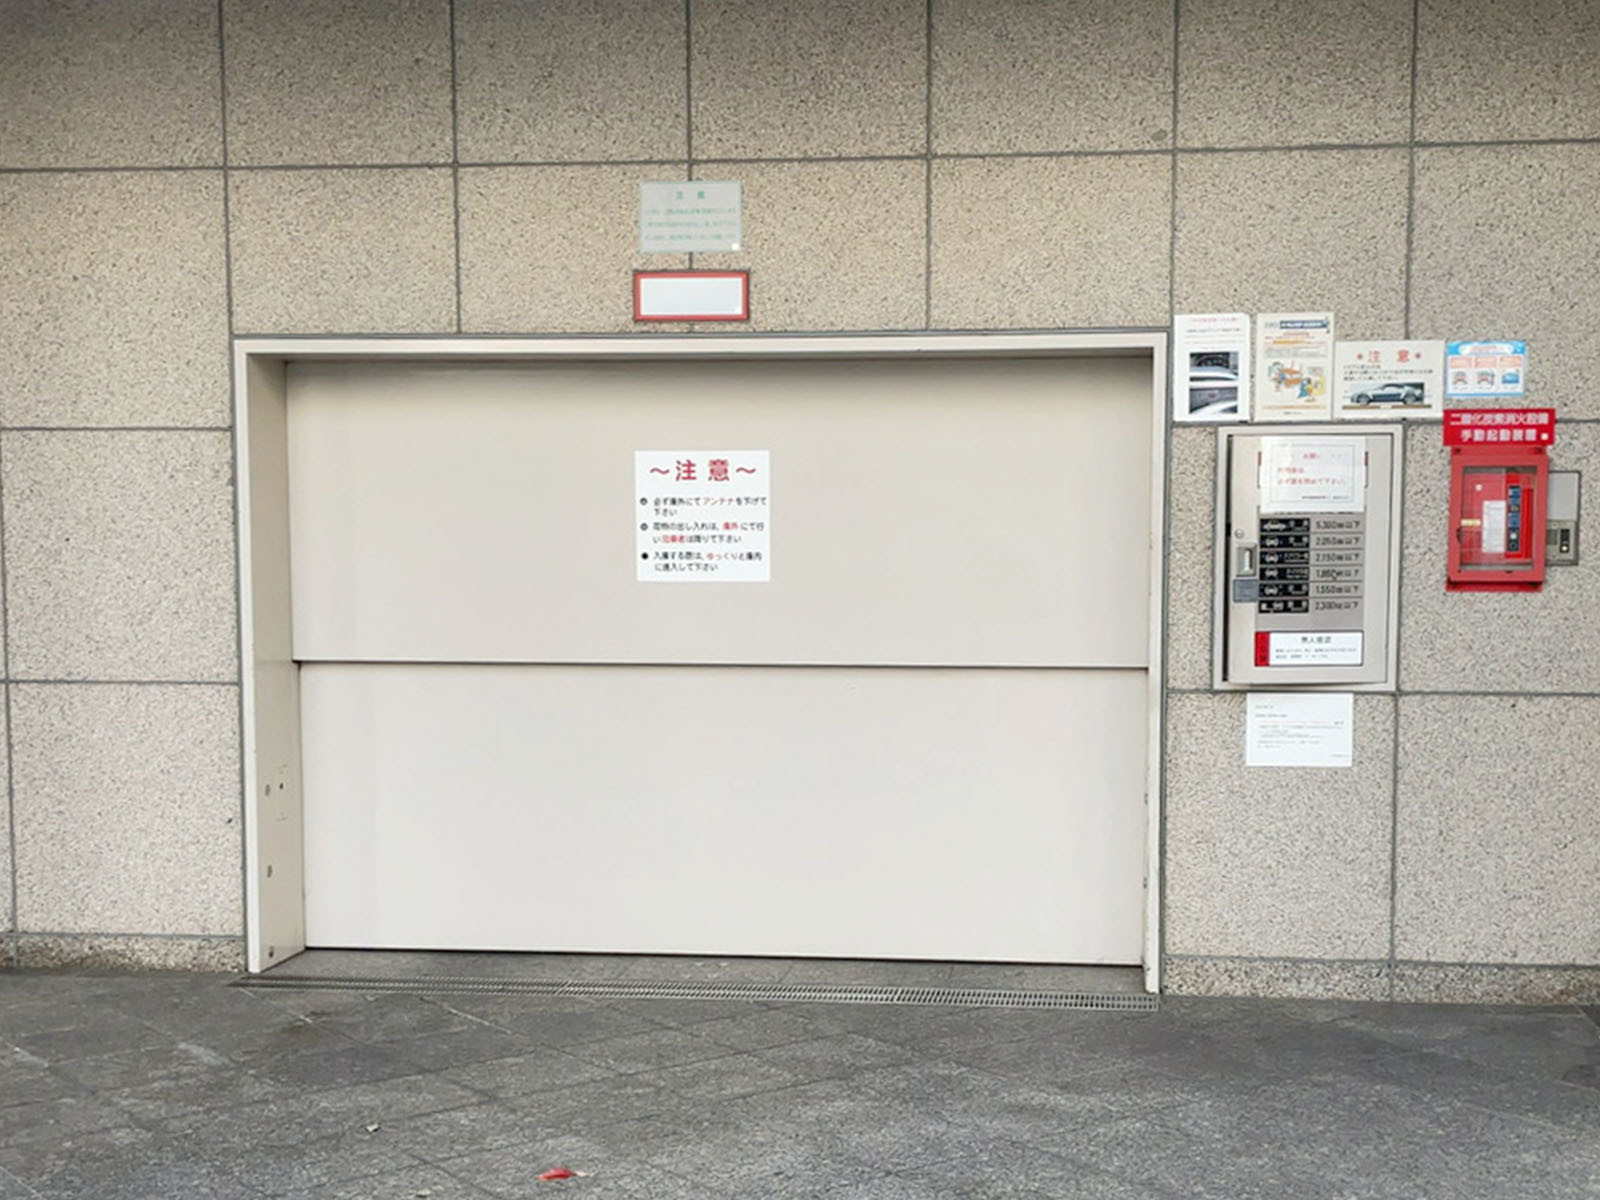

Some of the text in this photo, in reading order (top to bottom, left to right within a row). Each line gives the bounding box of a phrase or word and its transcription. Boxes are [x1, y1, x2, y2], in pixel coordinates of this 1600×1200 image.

[1461, 429, 1537, 442] 手動起動装置
